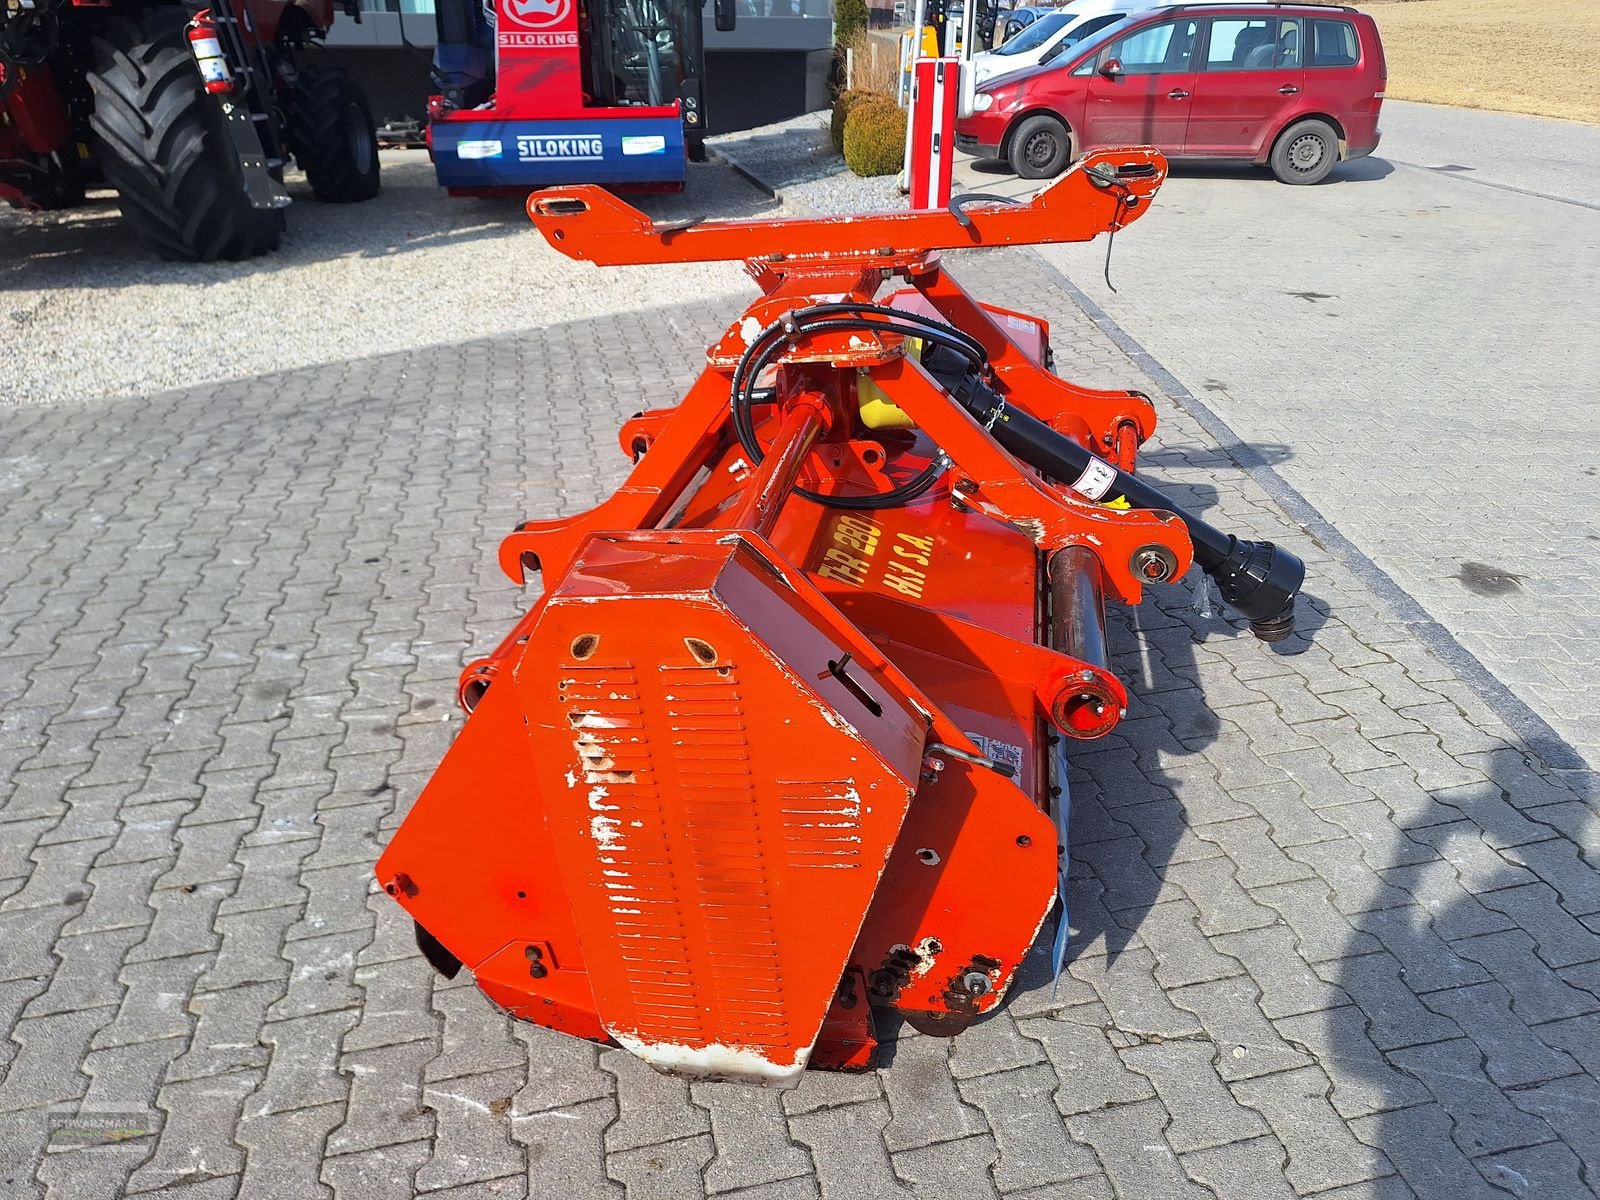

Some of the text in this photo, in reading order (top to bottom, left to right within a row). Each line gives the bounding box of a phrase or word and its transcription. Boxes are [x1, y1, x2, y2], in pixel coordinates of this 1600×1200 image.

[499, 34, 578, 45] SILOKING
[518, 138, 603, 157] SILOKING
[833, 515, 882, 556] 280
